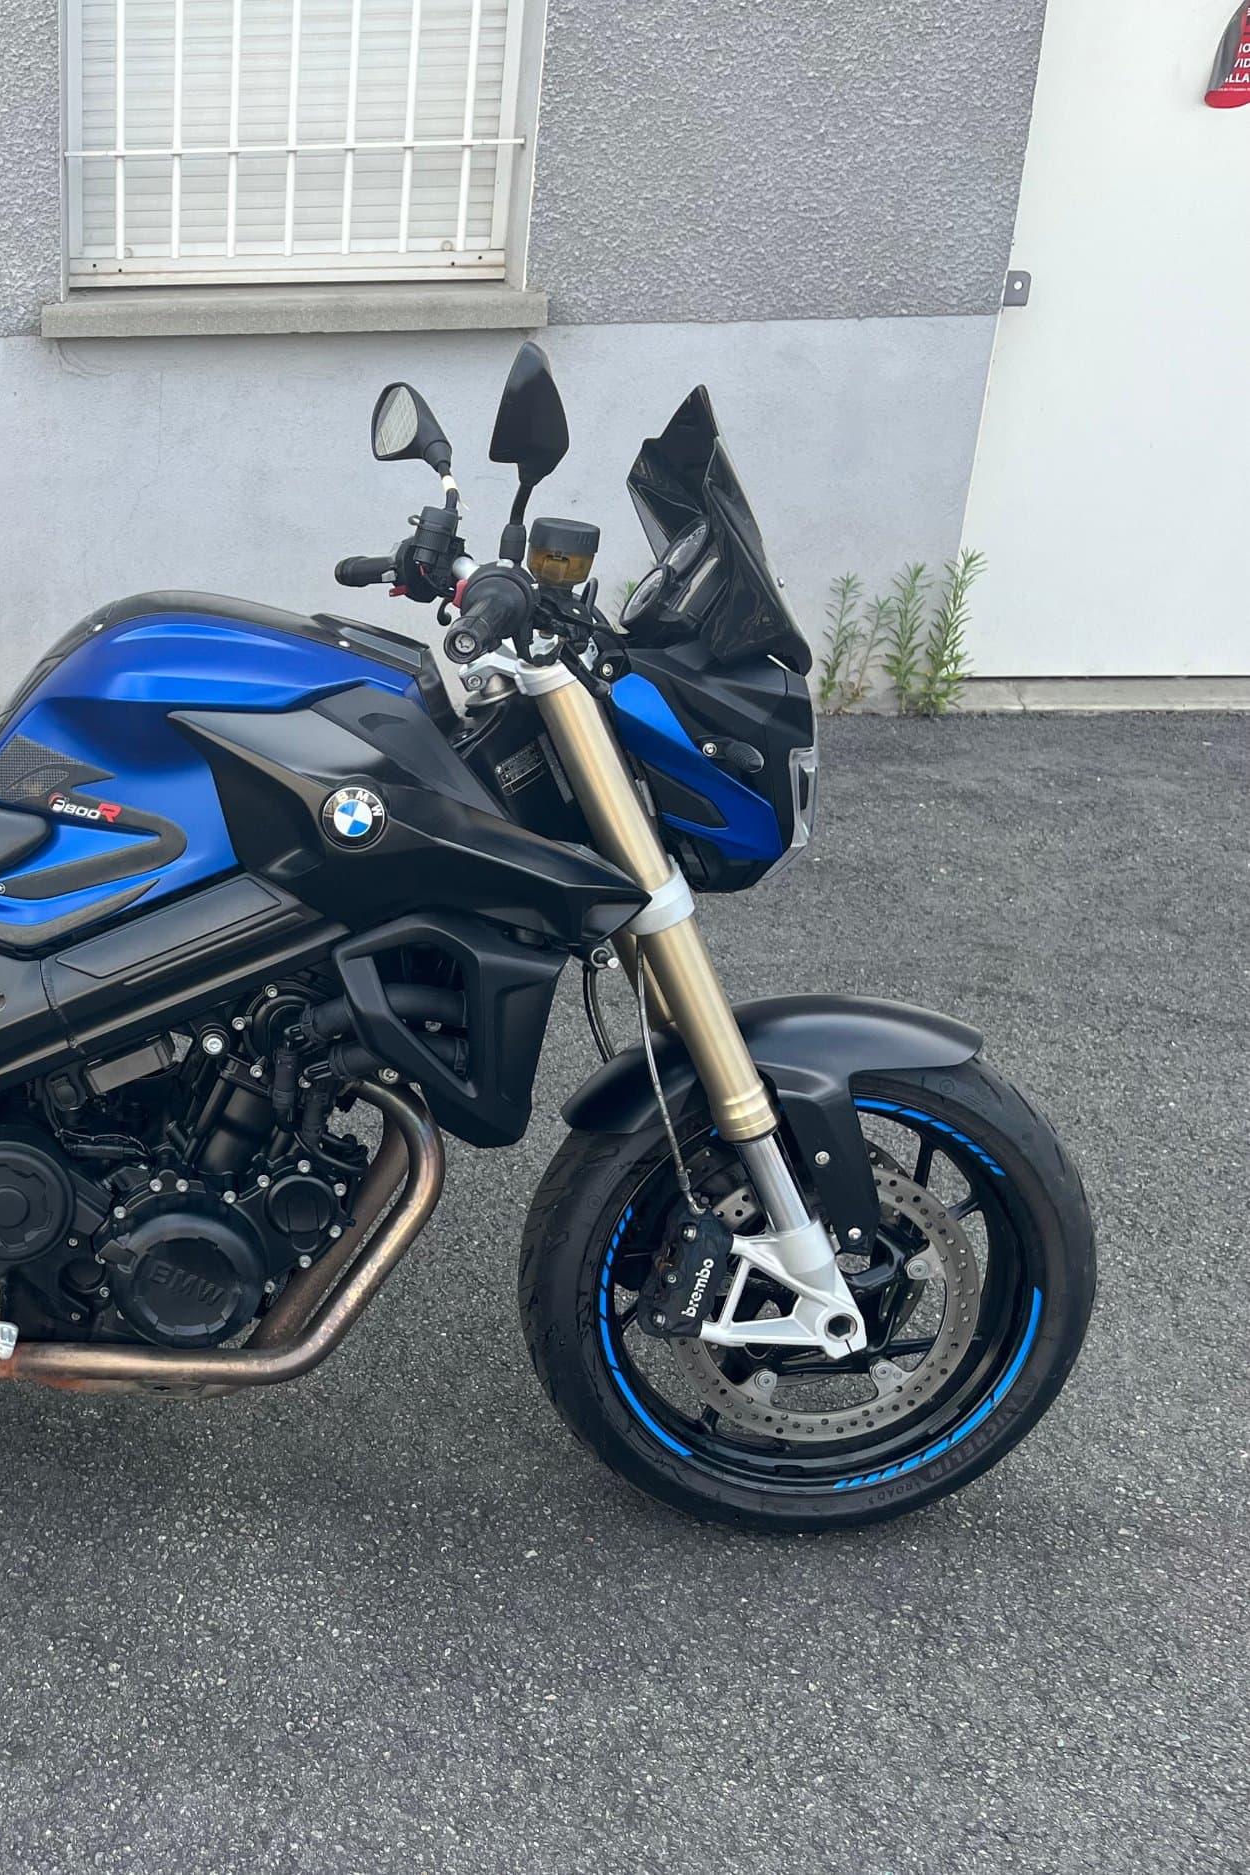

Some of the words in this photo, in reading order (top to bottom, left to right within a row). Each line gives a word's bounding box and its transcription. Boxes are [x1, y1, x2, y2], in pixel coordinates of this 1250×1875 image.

[335, 790, 383, 817] BMW
[151, 1258, 225, 1306] BMW
[681, 1258, 714, 1318] brembo
